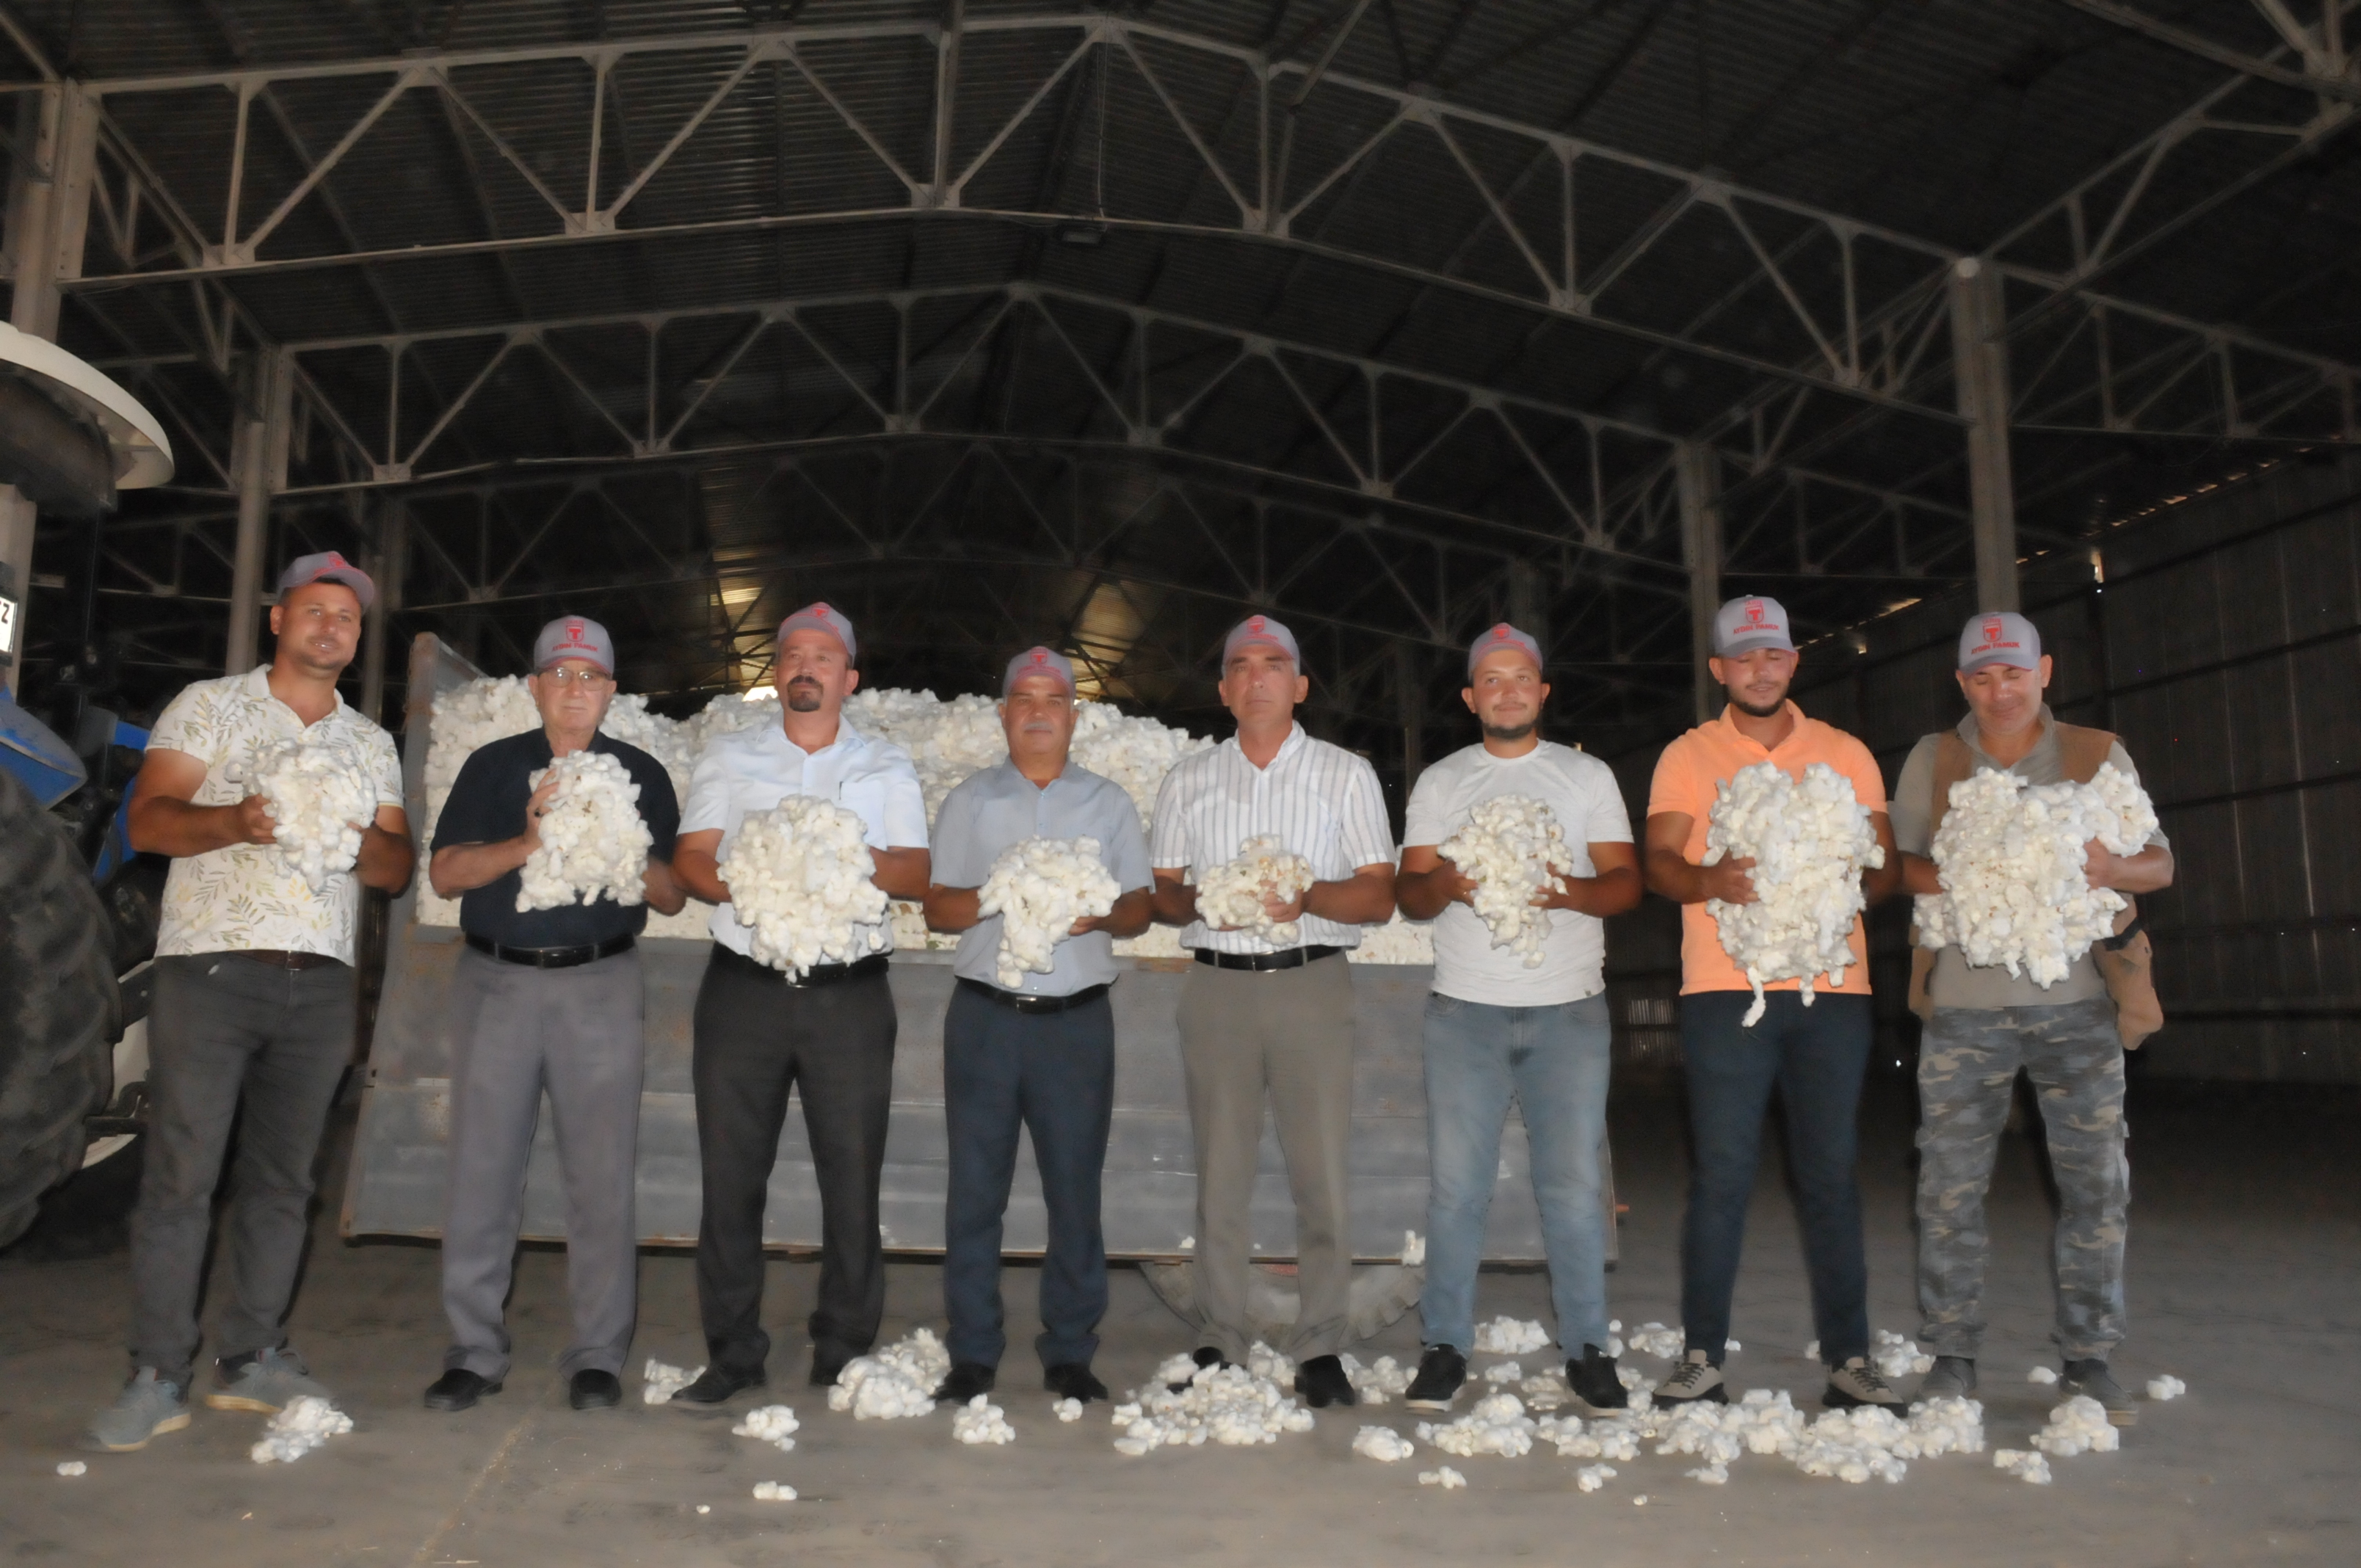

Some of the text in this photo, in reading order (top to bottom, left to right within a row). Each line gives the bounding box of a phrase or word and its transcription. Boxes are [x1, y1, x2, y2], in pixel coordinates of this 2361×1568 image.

[1748, 609, 1760, 620] T
[569, 628, 581, 639] T
[1986, 628, 1999, 639] T
